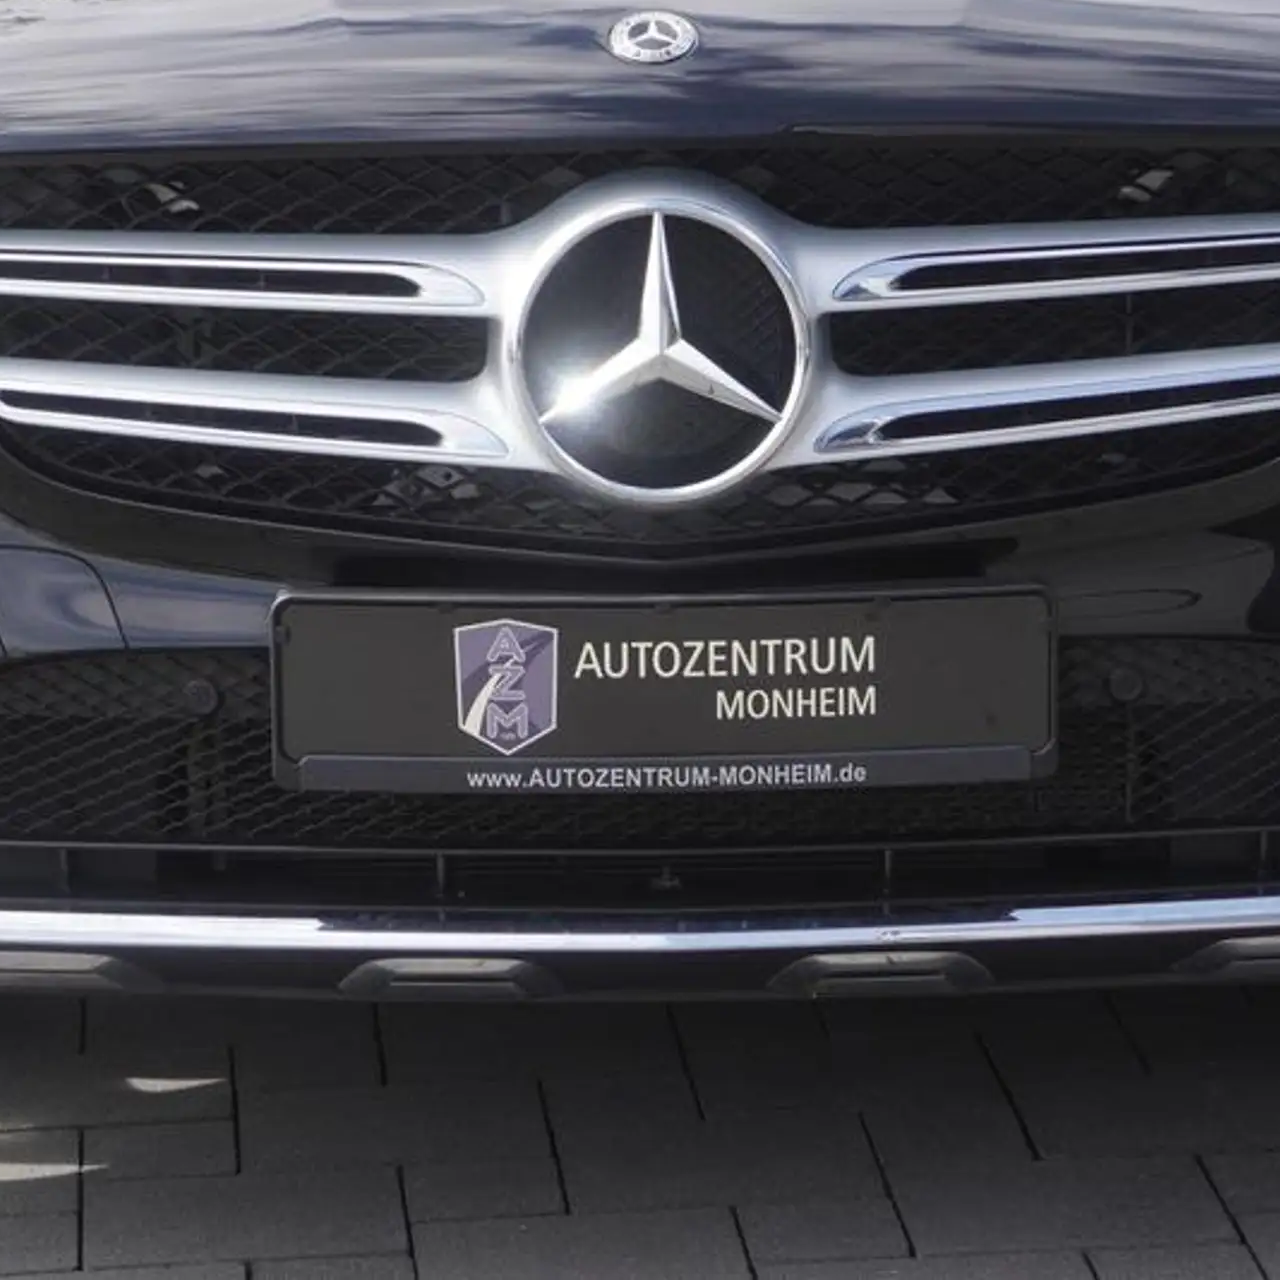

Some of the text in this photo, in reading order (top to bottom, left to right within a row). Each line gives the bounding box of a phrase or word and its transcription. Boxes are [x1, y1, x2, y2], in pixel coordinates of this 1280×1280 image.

[573, 635, 876, 680] AUTOZENTRUM
[486, 626, 529, 739] AZM
[716, 685, 877, 720] MONHEIM
[466, 762, 868, 790] www.AUTOZENTRUM-MONHEIM.de
